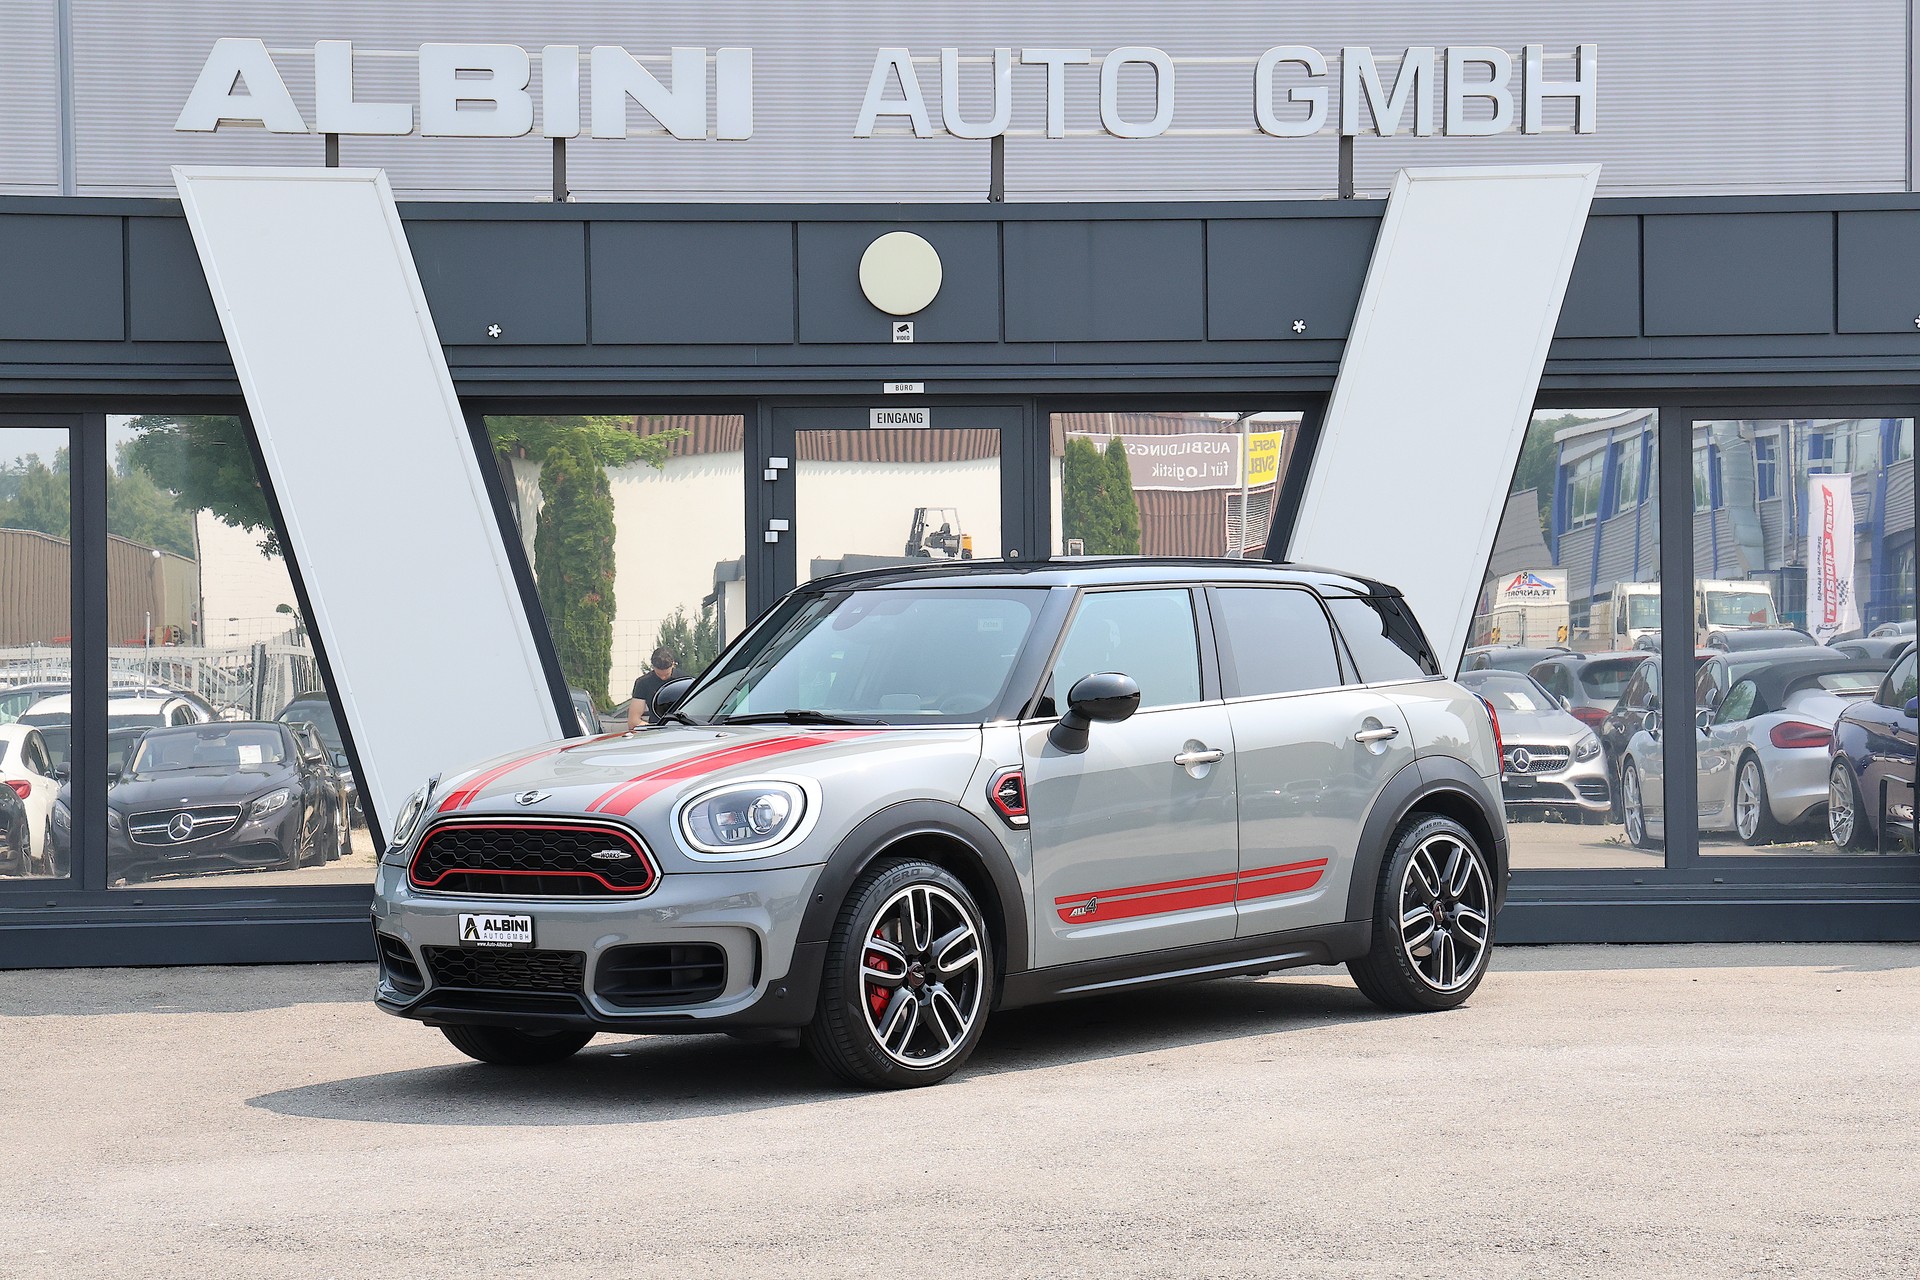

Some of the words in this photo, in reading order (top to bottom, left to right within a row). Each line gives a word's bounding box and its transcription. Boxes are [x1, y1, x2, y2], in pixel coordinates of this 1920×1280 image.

[174, 36, 753, 141] ALBINI
[853, 46, 1175, 139] AUTO
[1253, 43, 1598, 137] GMBH
[895, 383, 913, 391] BÜRO
[877, 412, 923, 424] EINGANG
[1824, 495, 1834, 534] PNEU
[883, 868, 921, 890] ZERO
[1069, 896, 1098, 917] ALL4
[483, 919, 529, 932] ALBINI
[484, 932, 504, 940] AUTO
[507, 933, 529, 941] GMBH
